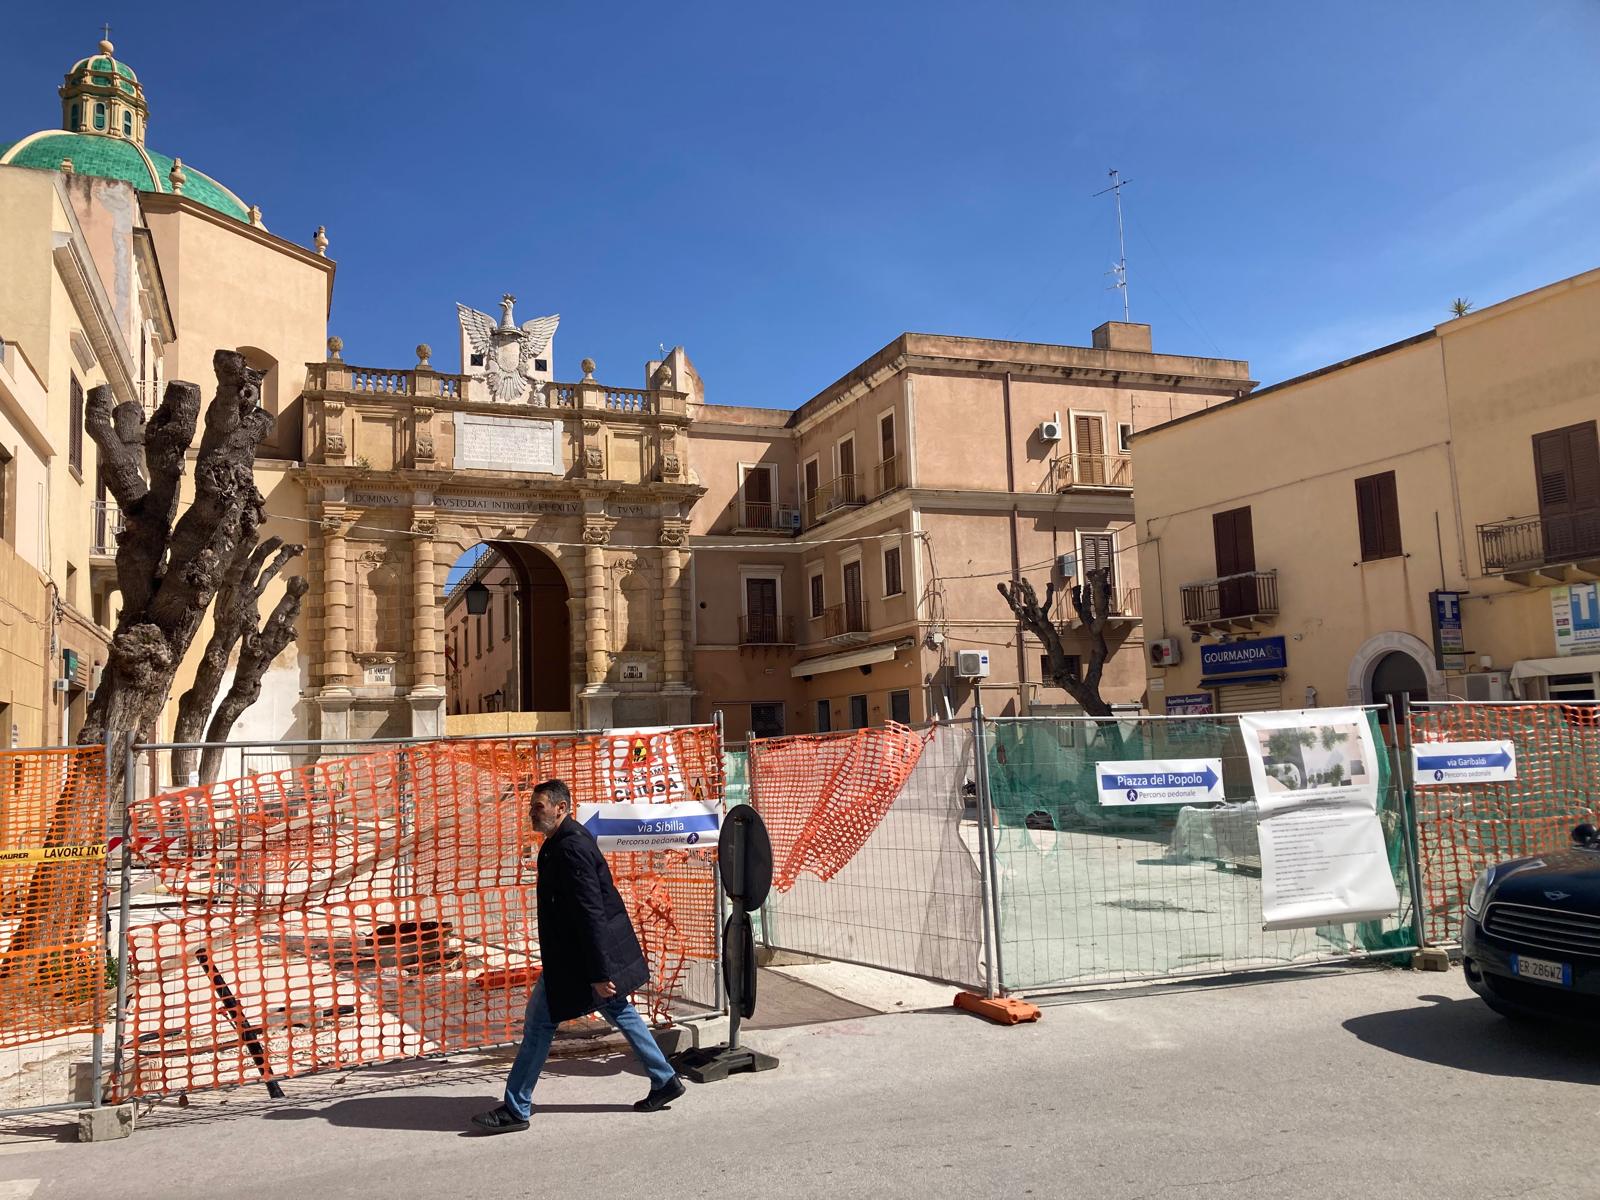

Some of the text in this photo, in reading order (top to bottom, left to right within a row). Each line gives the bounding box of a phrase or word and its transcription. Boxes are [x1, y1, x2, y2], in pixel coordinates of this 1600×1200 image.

[355, 494, 400, 504] DOMINVS
[433, 498, 488, 509] CVSTODIAT
[1204, 647, 1266, 664] GOURMANDIA
[1446, 757, 1487, 767] via Garibaldi
[1117, 774, 1203, 787] Piazza del Popolo
[1139, 790, 1197, 799] Percorso pedonale
[637, 821, 685, 833] via Sibilla
[616, 835, 686, 846] Percorso pedonale
[44, 847, 84, 859] LAVORI
[86, 846, 99, 856] IN
[1519, 959, 1530, 974] ER
